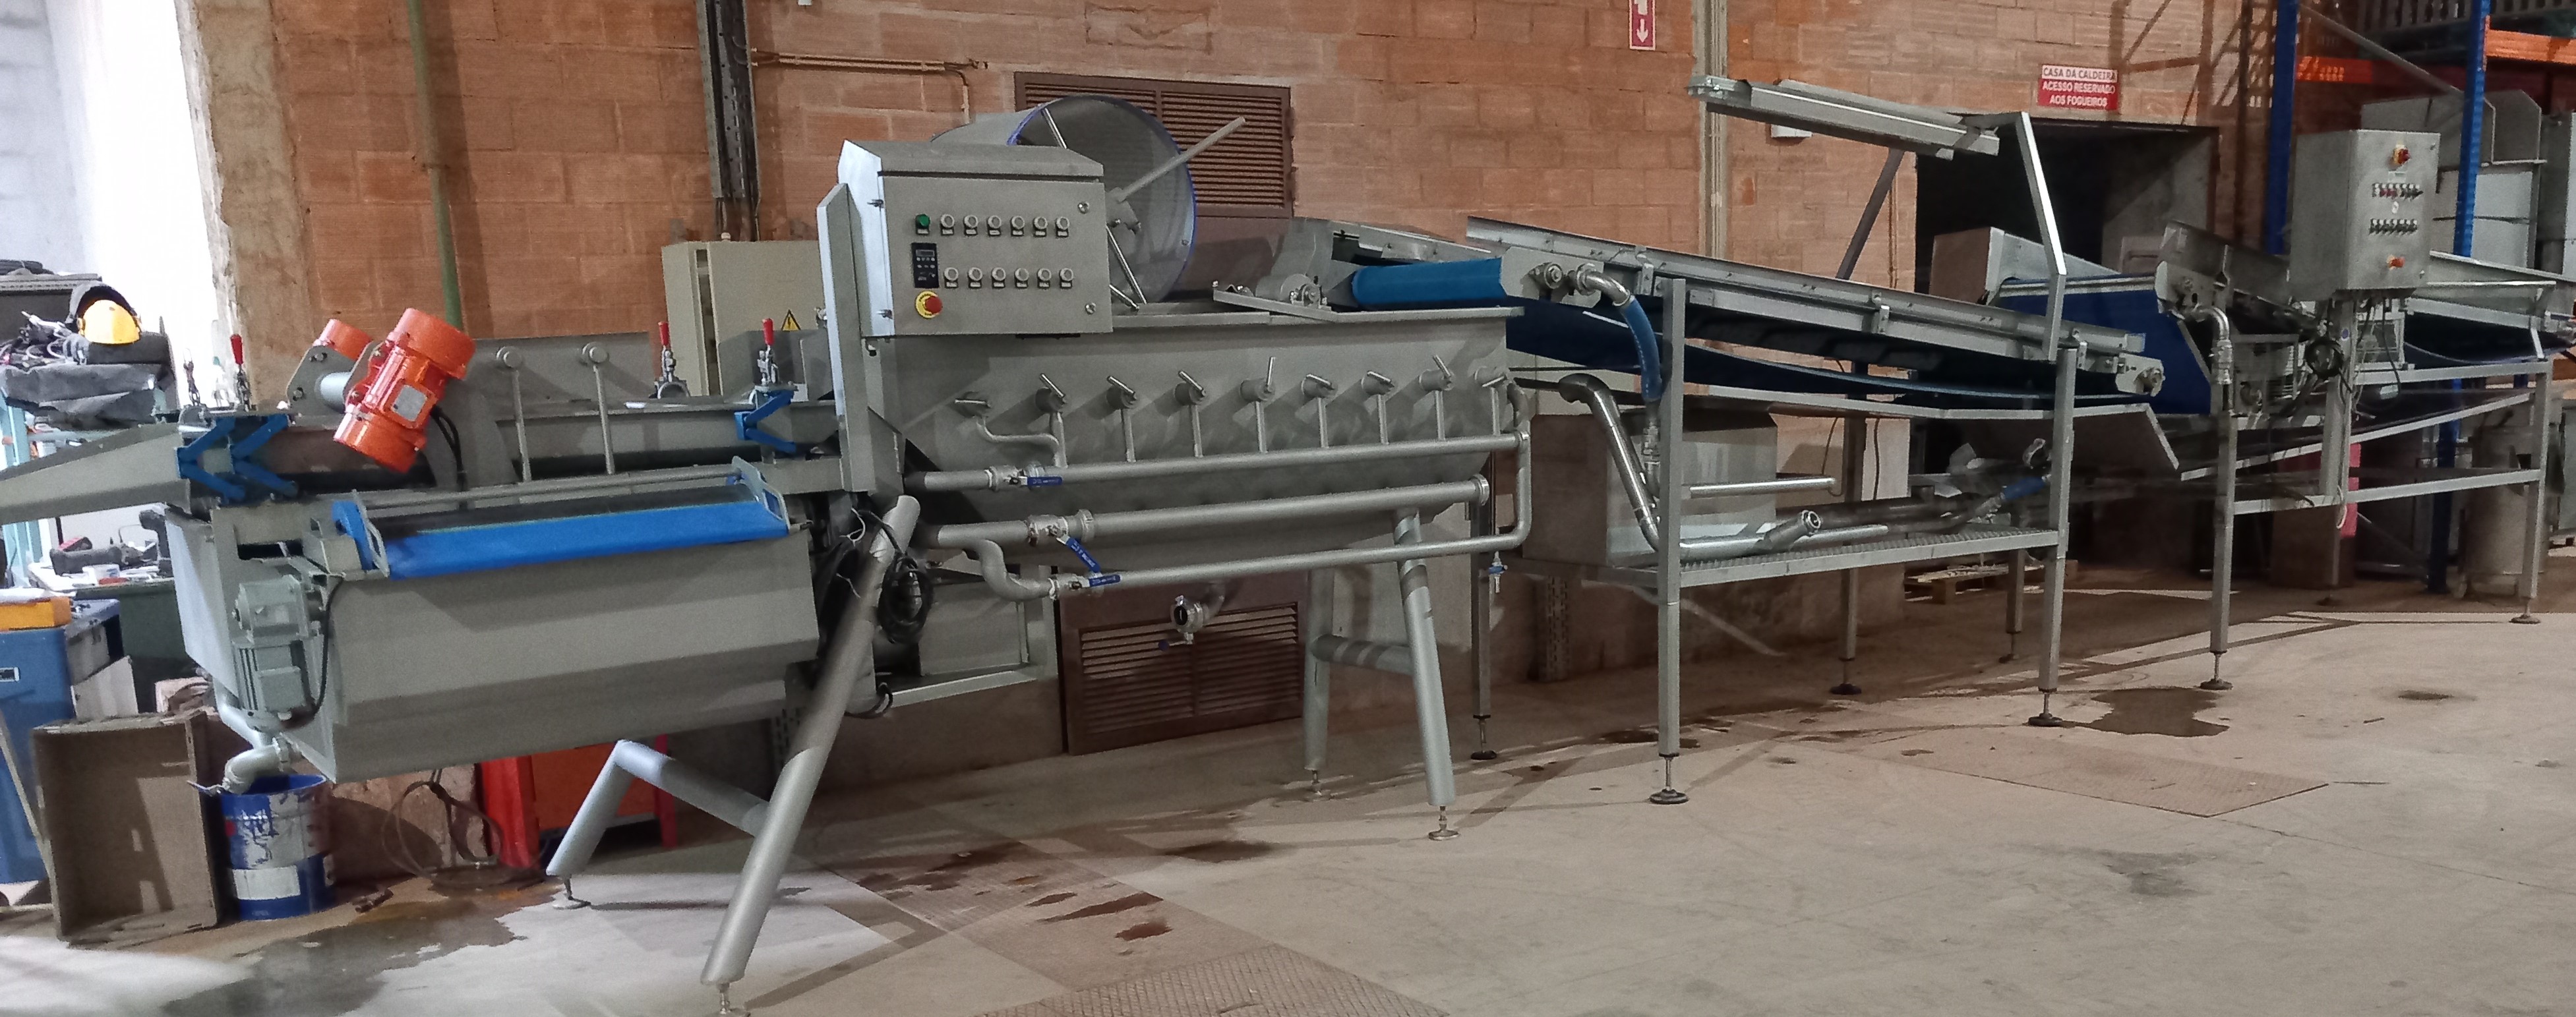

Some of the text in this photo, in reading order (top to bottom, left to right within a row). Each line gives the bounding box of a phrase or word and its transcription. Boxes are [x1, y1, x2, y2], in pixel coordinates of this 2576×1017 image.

[2044, 67, 2116, 80] CASA DA CALDEIRA
[2043, 81, 2115, 94] ACESSO RESERVADO
[2049, 94, 2107, 107] AOS FOGUEIROS
